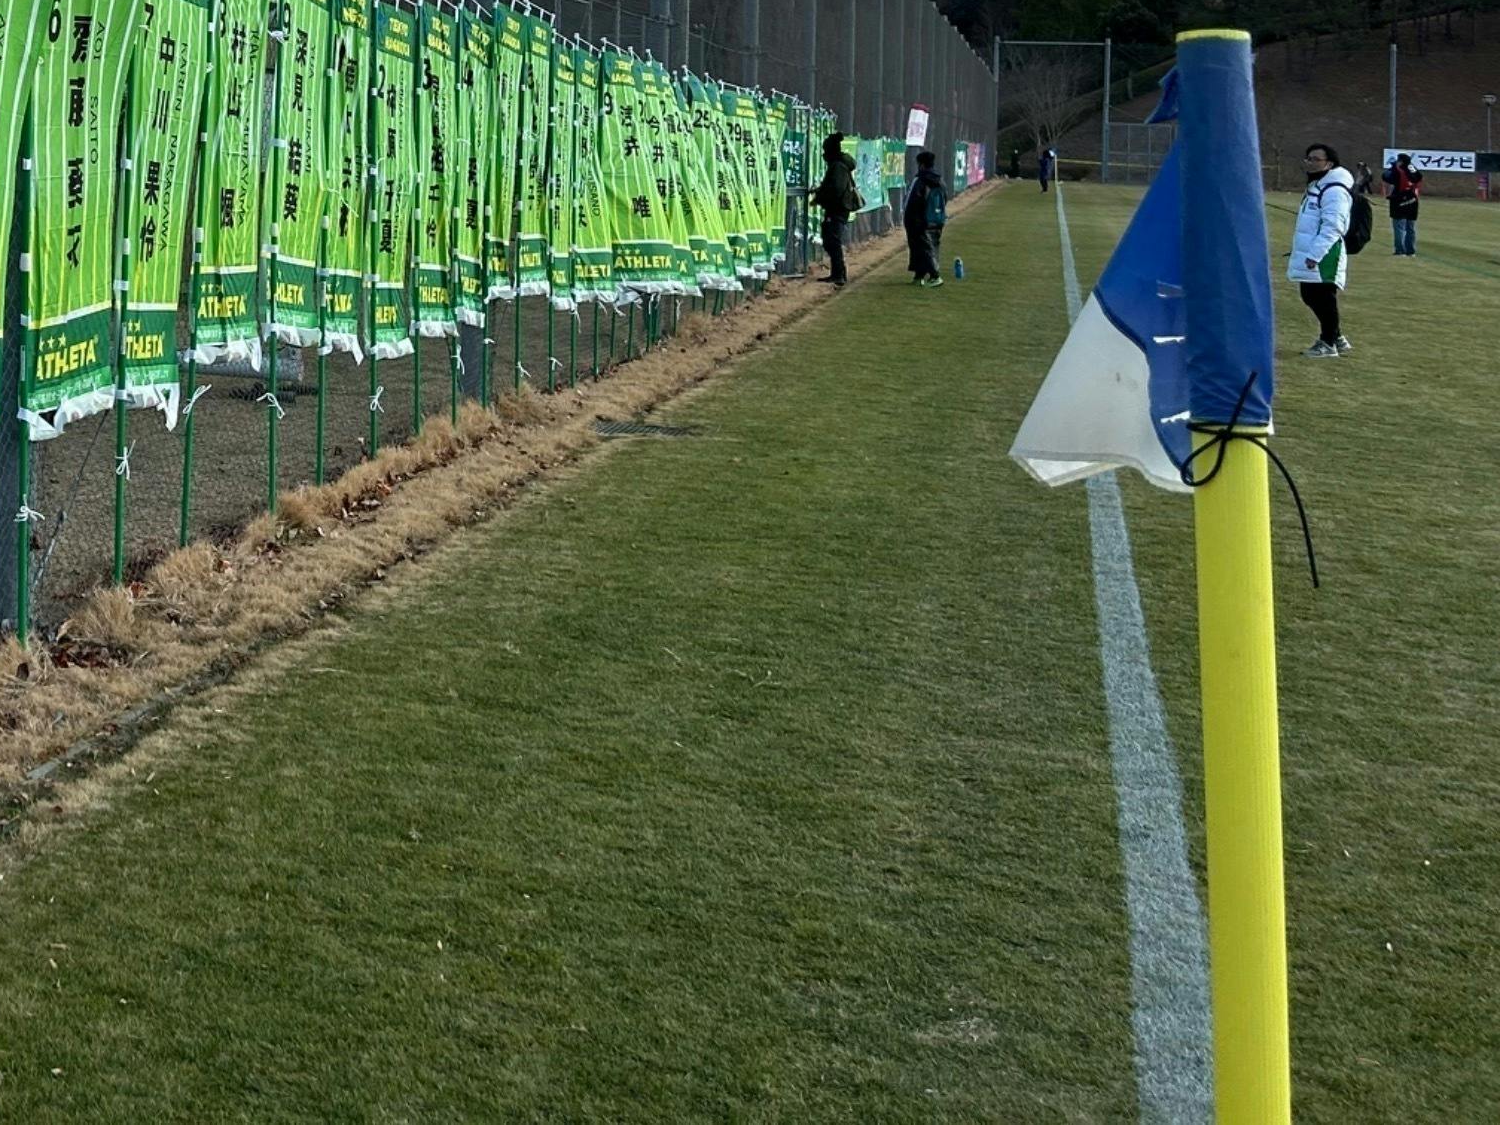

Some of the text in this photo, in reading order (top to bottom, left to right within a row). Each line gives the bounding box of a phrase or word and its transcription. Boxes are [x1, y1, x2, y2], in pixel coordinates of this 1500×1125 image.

[144, 3, 154, 49] 7
[283, 2, 291, 41] 9
[94, 20, 106, 61] AOI
[1418, 155, 1472, 169] マイナビ
[614, 256, 672, 269] ATHLETA
[126, 335, 163, 359] THLETA
